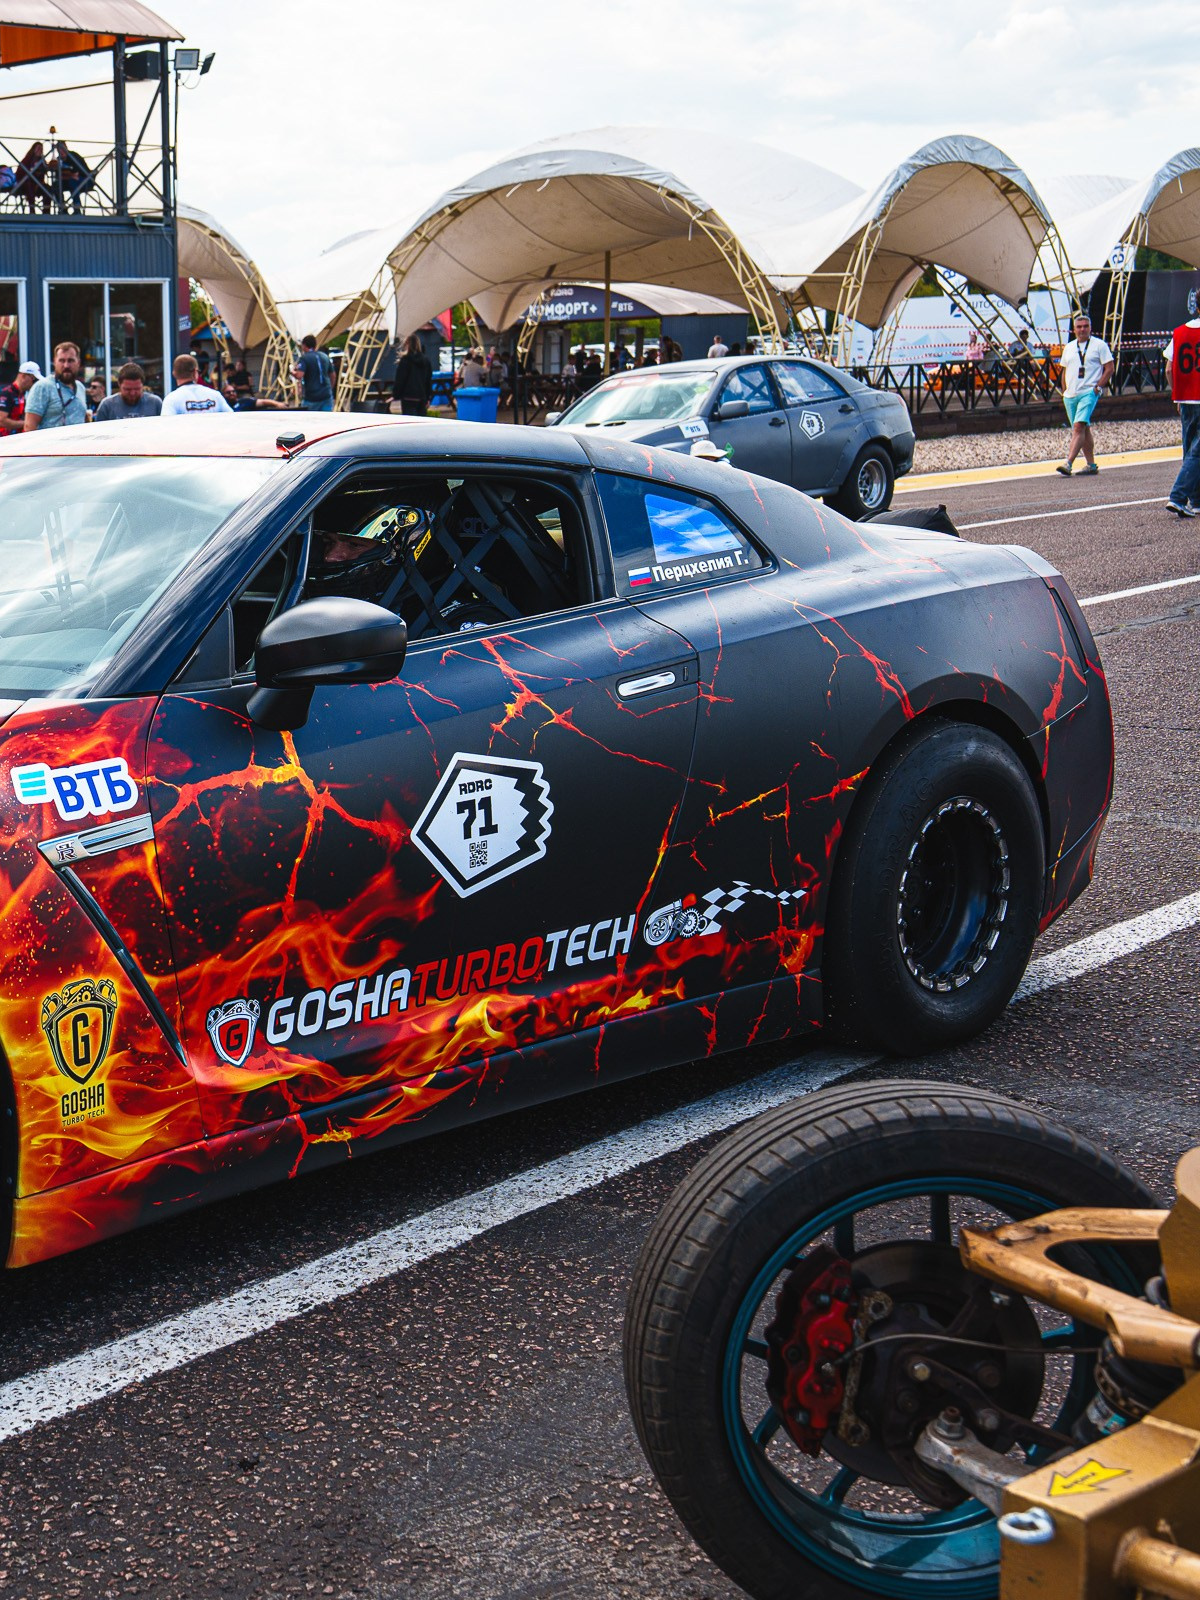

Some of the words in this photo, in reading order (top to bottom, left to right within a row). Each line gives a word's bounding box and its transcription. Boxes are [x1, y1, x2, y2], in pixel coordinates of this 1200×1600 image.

[652, 555, 734, 582] Перцхелия
[734, 550, 749, 566] Г.
[53, 765, 132, 813] ВТБ
[459, 779, 493, 795] RDRC
[456, 796, 499, 840] 71
[72, 1012, 91, 1067] G
[61, 1082, 105, 1118] GOSHA
[62, 1114, 85, 1127] TURBO
[87, 1107, 105, 1119] TECH
